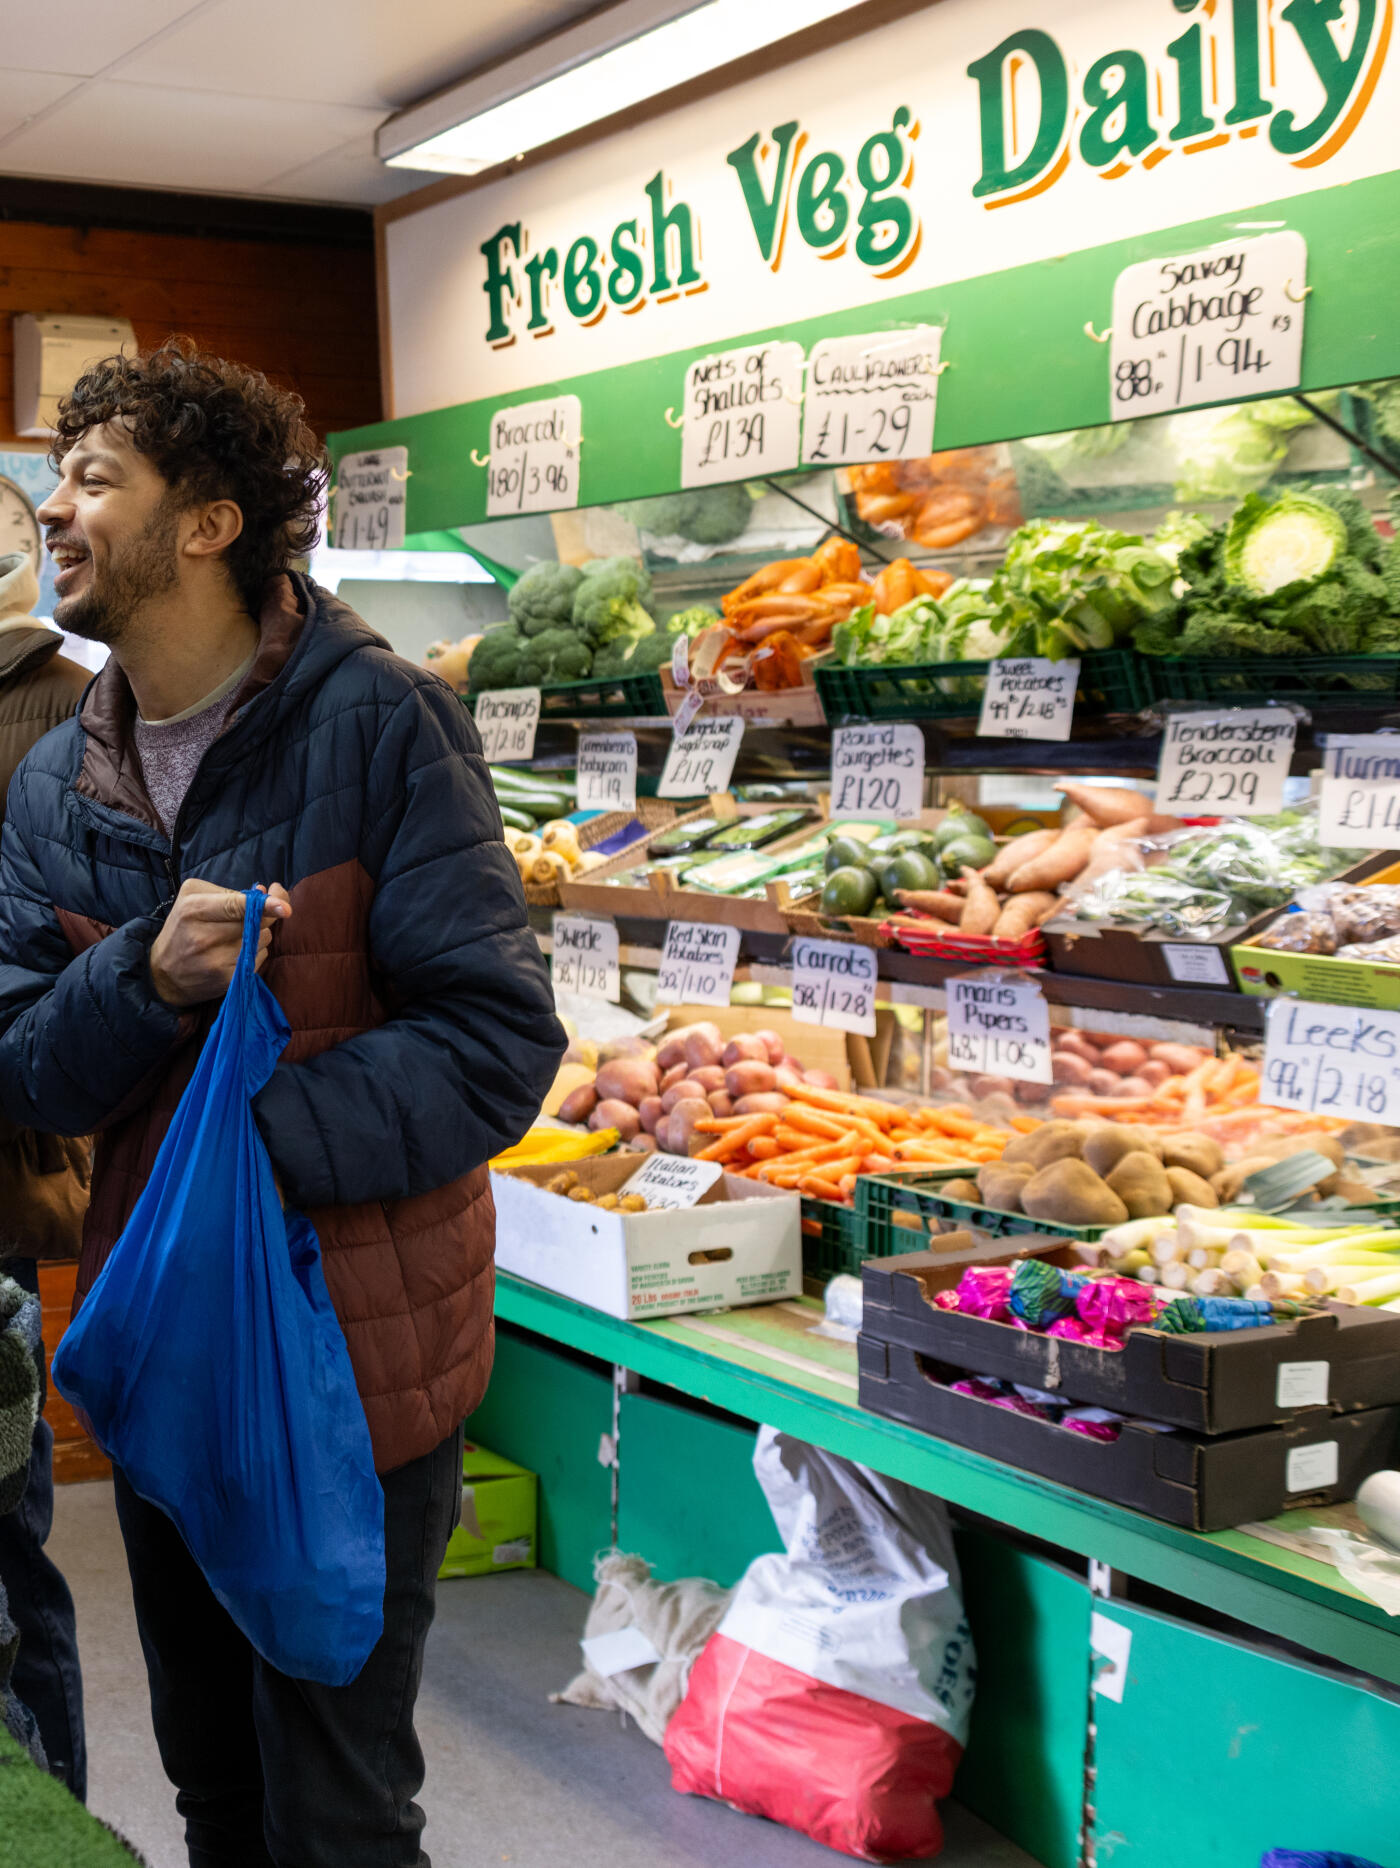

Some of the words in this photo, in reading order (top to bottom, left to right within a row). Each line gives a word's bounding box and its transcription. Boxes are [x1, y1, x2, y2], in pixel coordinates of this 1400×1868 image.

[481, 169, 703, 343] Fresh
[726, 104, 914, 269] Veg
[966, 0, 1384, 199] Daily
[1159, 252, 1246, 294] Savoy
[1131, 286, 1264, 340] Cabbage
[495, 408, 566, 450] Broccoli
[478, 695, 538, 722] Parsnips
[840, 725, 896, 746] Round
[834, 747, 915, 773] Courgettes
[1177, 743, 1277, 766] Broccoli
[554, 921, 603, 953] Swede
[795, 942, 873, 980] Carrots
[963, 1002, 1029, 1033] Pipers
[1284, 1006, 1397, 1059] Leeks
[646, 1157, 698, 1176] Italian
